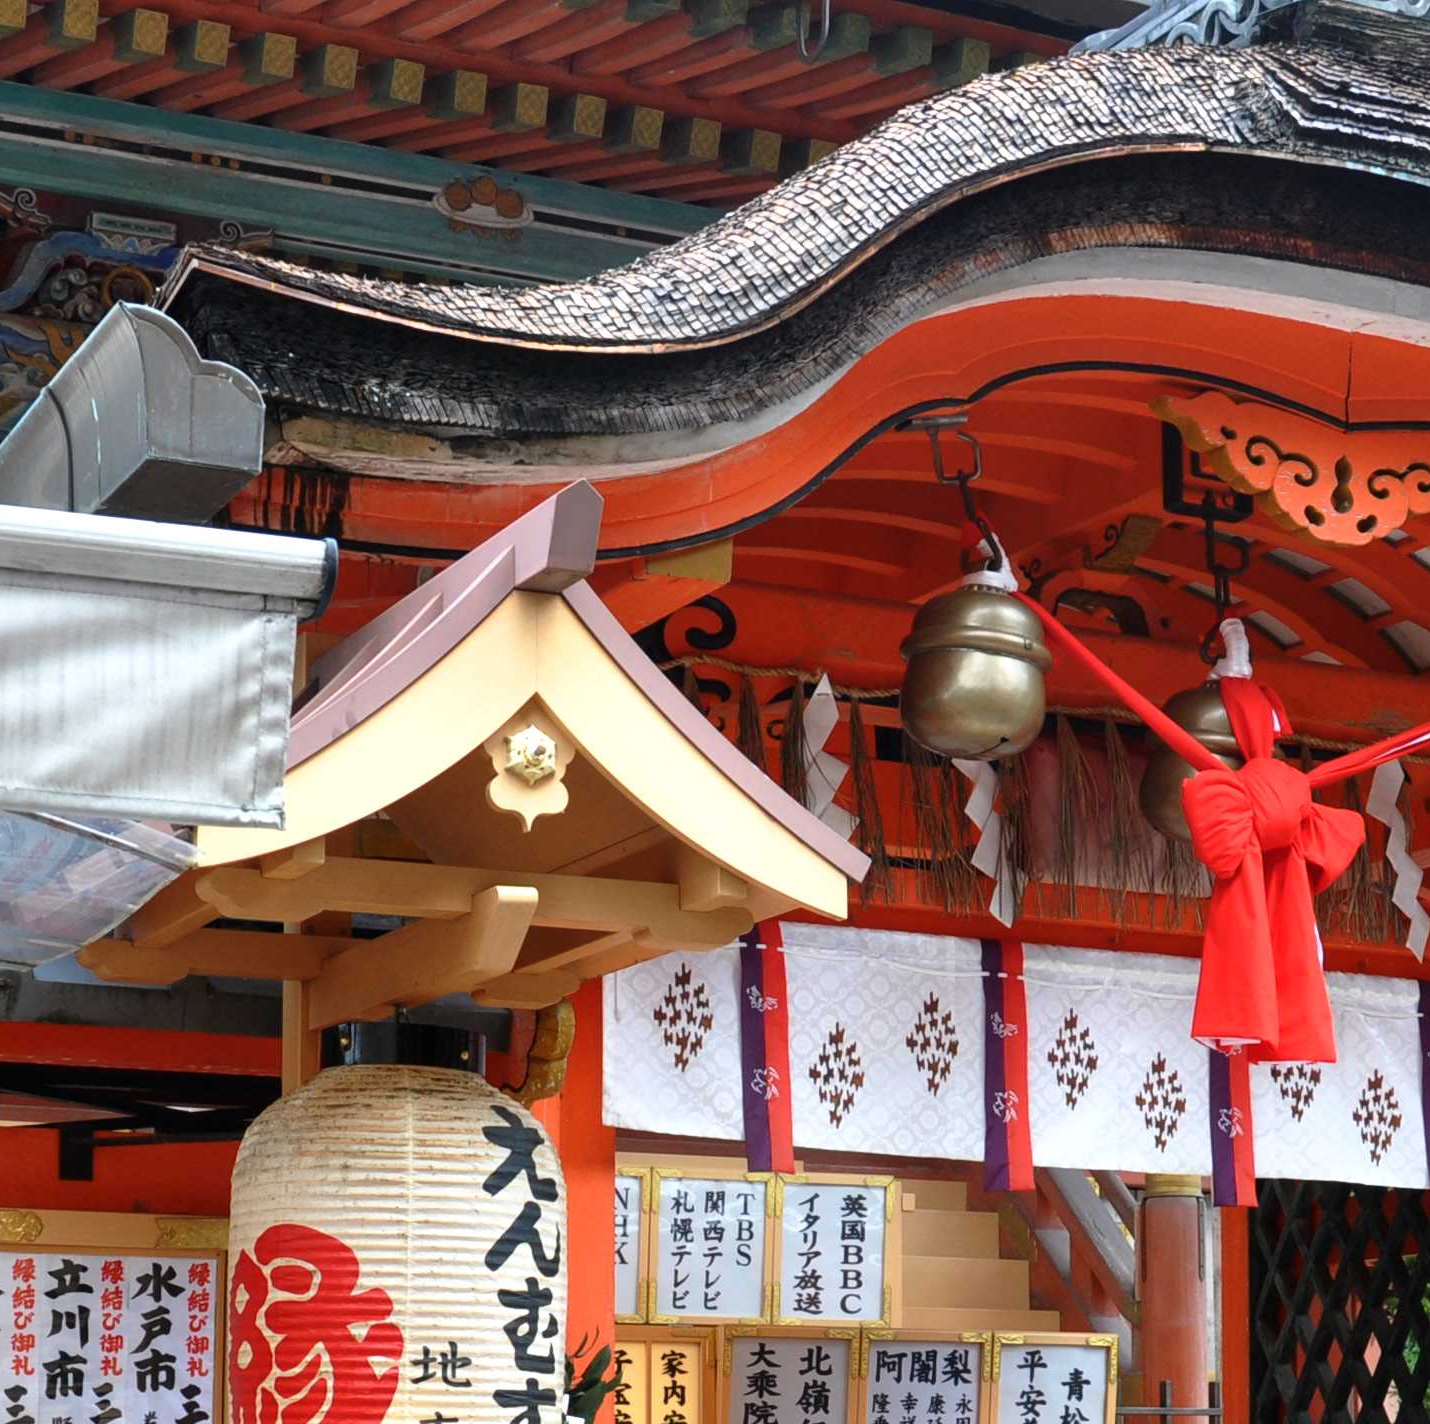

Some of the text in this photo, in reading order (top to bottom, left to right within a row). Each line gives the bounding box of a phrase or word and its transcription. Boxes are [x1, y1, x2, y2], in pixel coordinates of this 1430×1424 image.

[670, 1189, 696, 1310] 札幌テレビ
[702, 1190, 726, 1311] 関西テレビ
[735, 1193, 755, 1267] TBS
[793, 1193, 823, 1315] イタリア放送
[839, 1194, 868, 1314] 英国BBC
[11, 1258, 36, 1376] 縁結び御礼
[42, 1259, 94, 1399] 立川市
[99, 1260, 124, 1376] 縁結び御礼
[131, 1263, 186, 1392] 水戸市
[186, 1263, 212, 1377] 縁結び御礼
